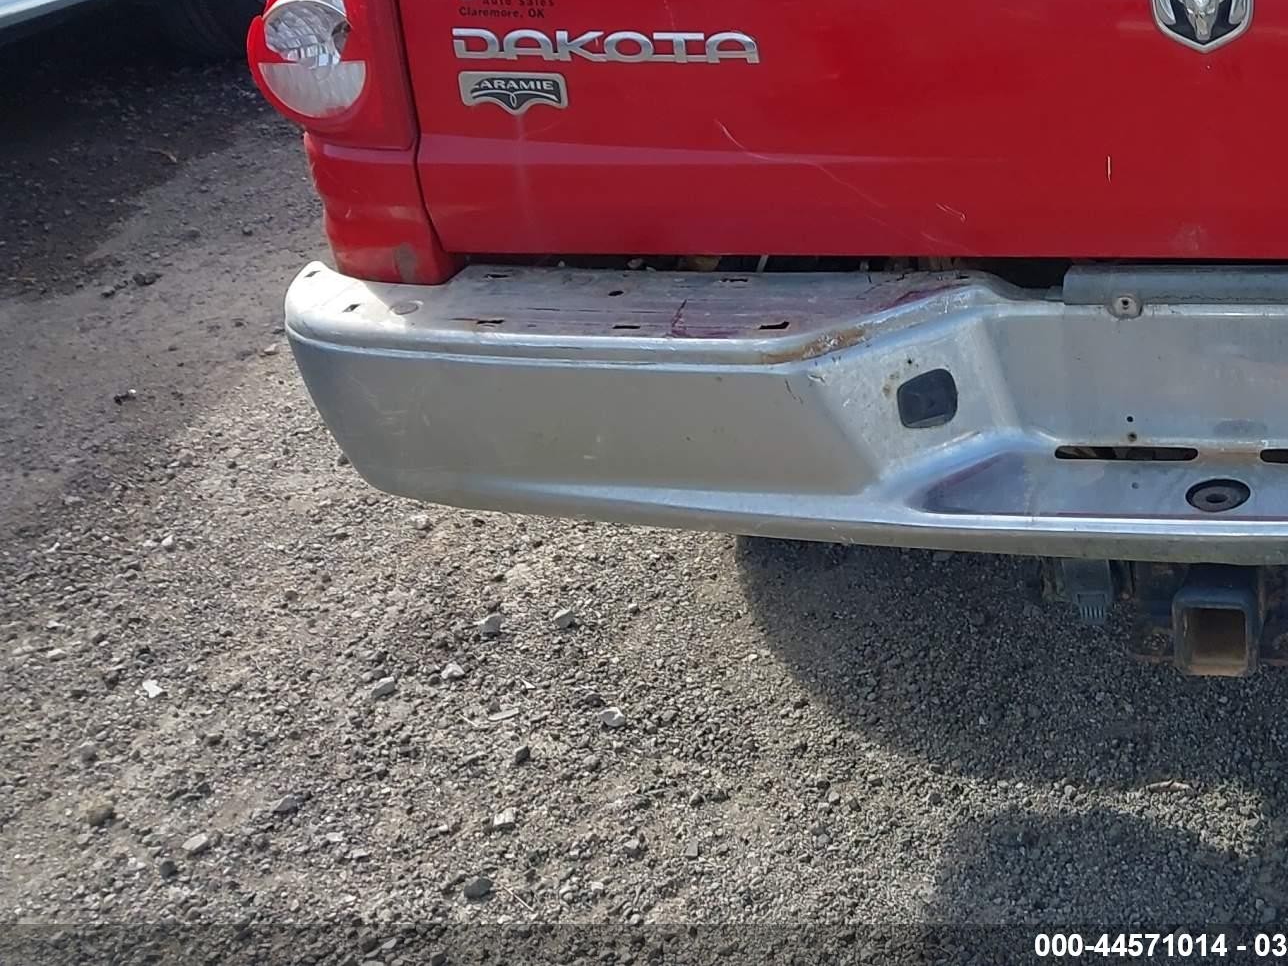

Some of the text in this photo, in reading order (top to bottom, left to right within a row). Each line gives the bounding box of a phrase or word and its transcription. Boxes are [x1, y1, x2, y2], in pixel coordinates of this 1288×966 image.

[459, 6, 545, 19] Claremore, OK
[452, 27, 760, 64] DAKOTA
